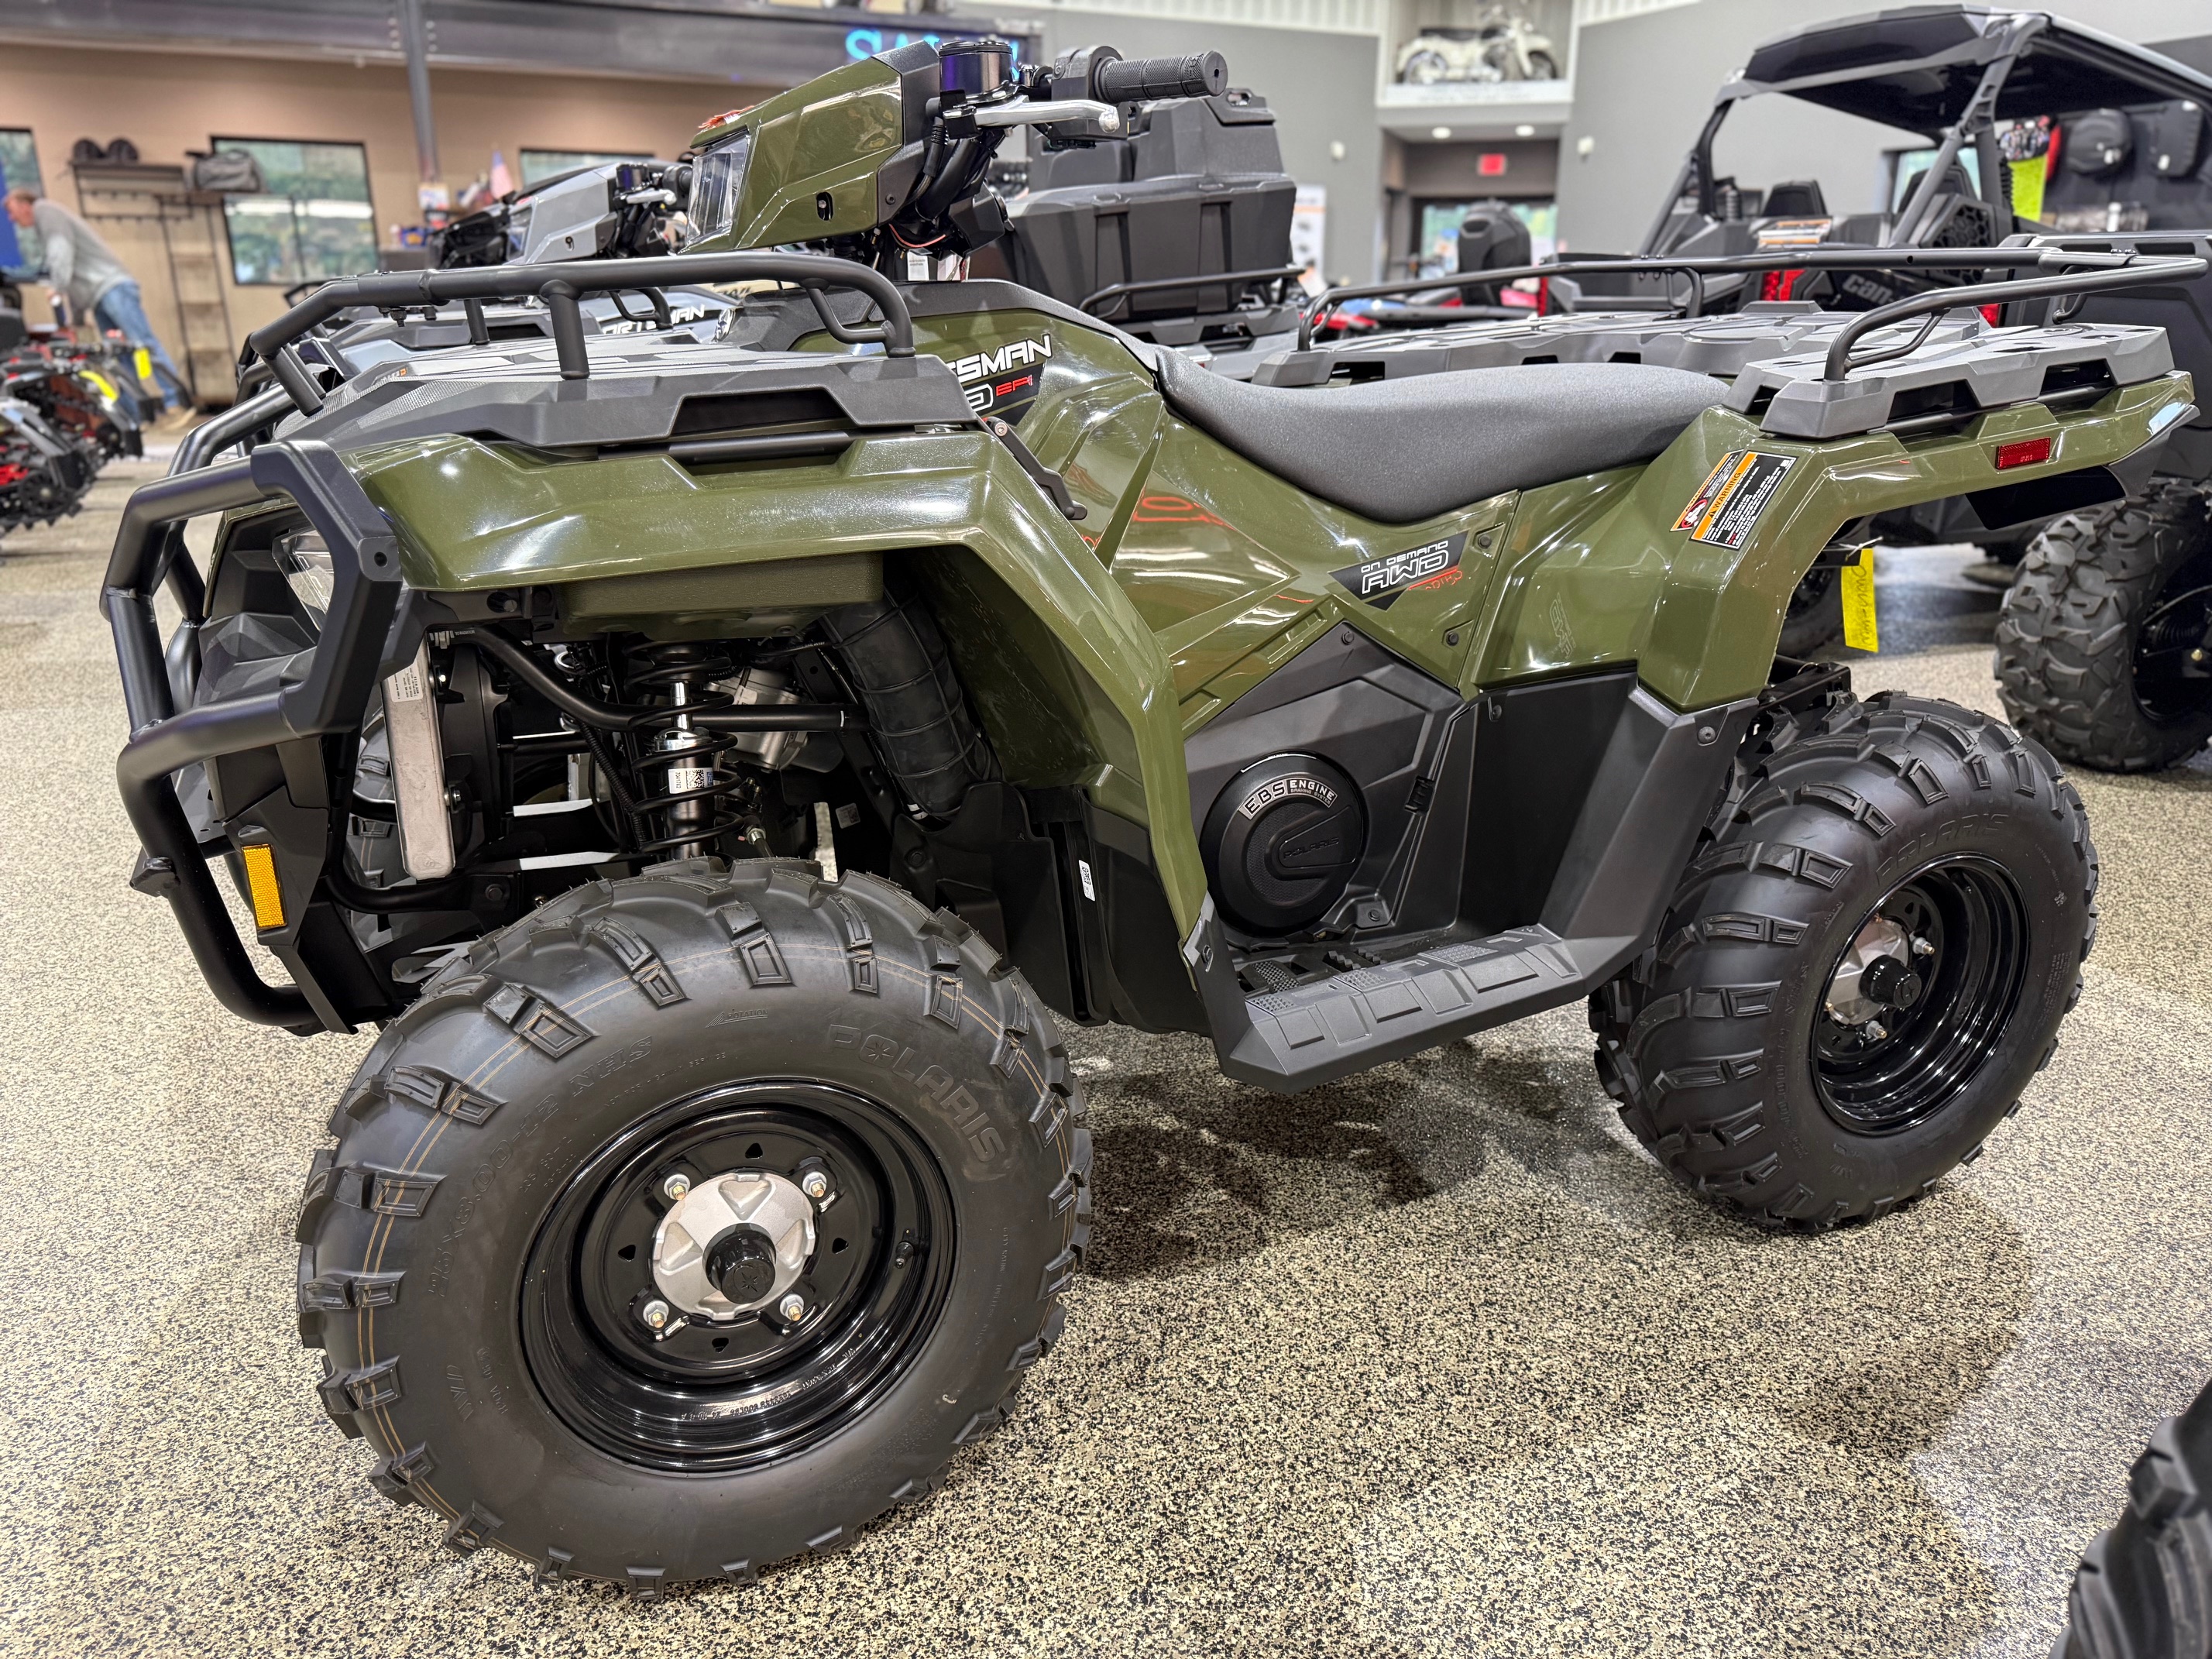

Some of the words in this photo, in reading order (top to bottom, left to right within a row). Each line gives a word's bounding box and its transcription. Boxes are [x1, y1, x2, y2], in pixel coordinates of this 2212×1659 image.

[1712, 472, 1741, 510] WARNING
[1361, 562, 1380, 573] ON
[1386, 541, 1448, 565] DEMAND
[1362, 550, 1449, 594] AWD
[1244, 781, 1286, 815] EBS
[1290, 780, 1334, 801] ENGINE
[1283, 837, 1339, 859] POLARIS
[727, 1008, 768, 1019] ROTATION
[568, 1036, 653, 1097] NHS
[830, 1024, 1006, 1162] POLARIS
